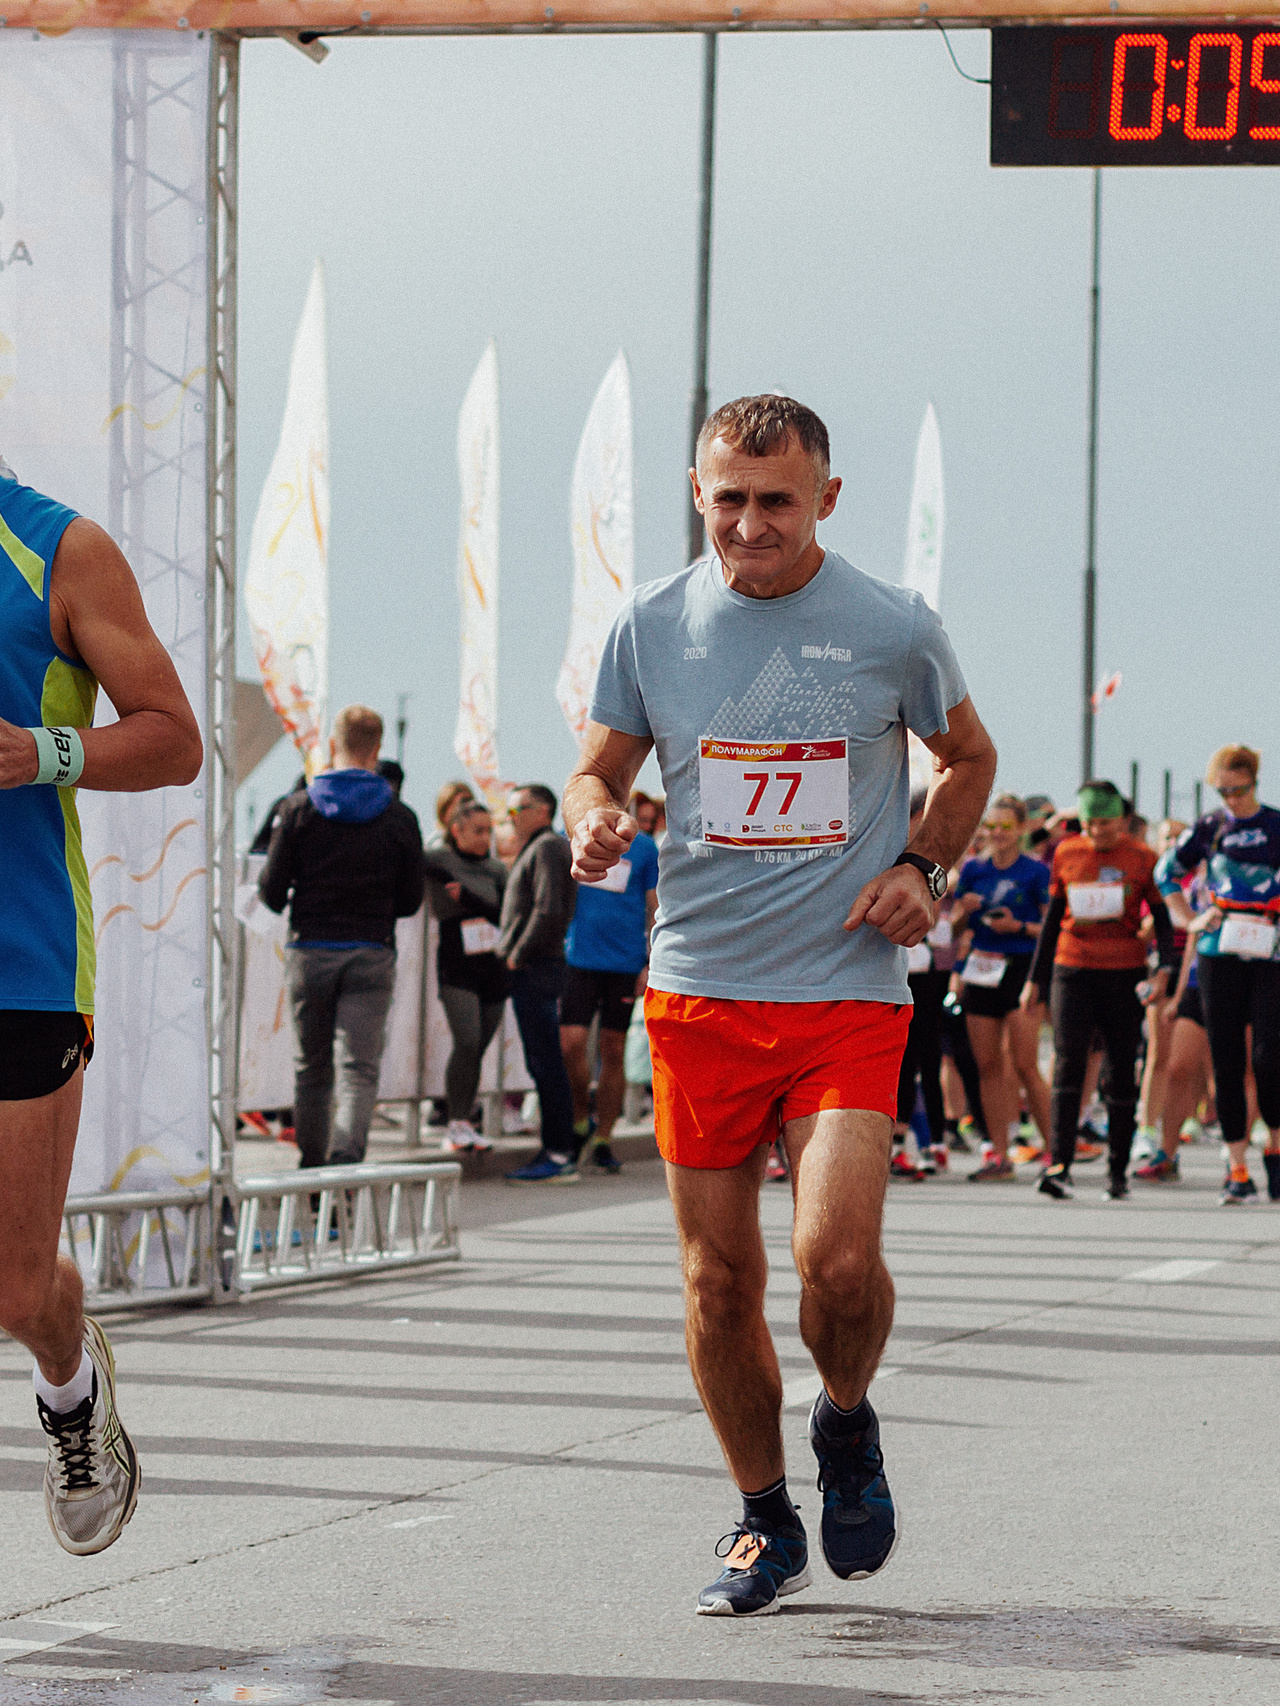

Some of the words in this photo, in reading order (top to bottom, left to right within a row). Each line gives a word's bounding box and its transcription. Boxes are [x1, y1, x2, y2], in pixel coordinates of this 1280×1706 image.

[683, 646, 708, 660] 2020
[711, 745, 783, 756] ПОЛУМАРАФОН
[743, 772, 803, 816] 77
